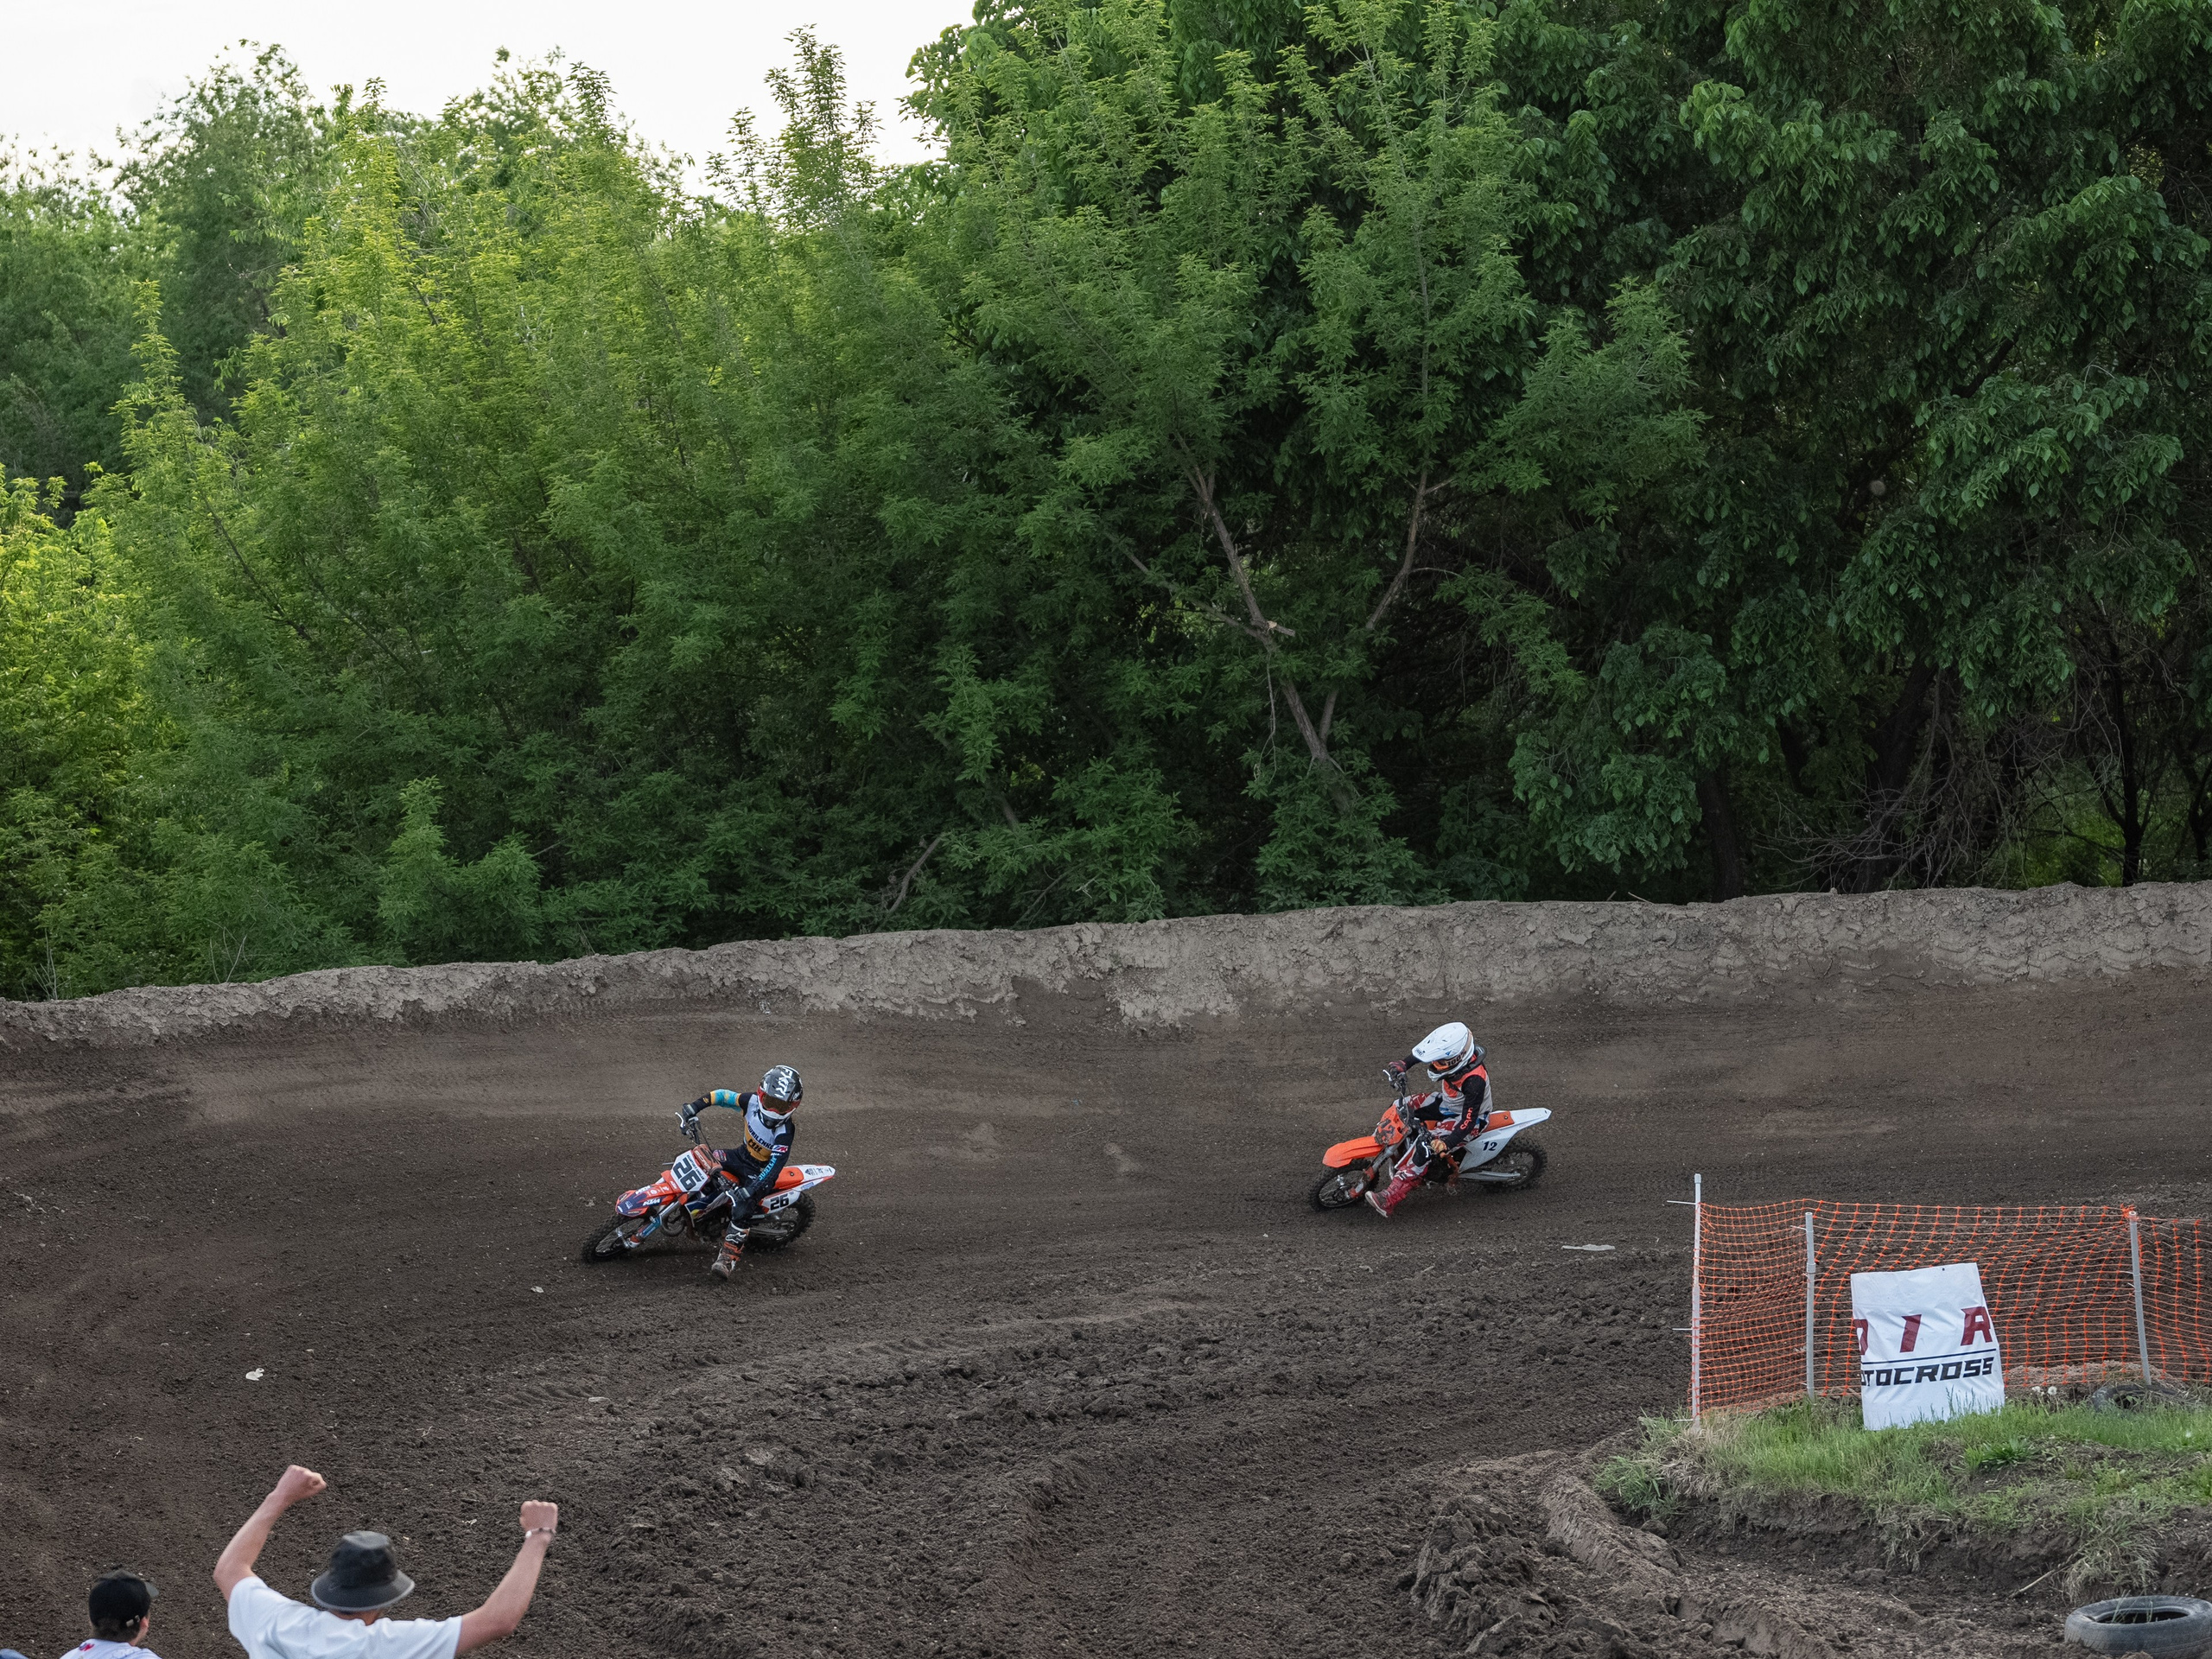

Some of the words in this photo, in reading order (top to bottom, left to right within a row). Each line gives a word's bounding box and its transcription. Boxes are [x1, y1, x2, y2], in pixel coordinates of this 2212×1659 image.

[1446, 1049, 1466, 1066] 100%
[1483, 1141, 1497, 1151] 12
[673, 1157, 702, 1191] 26
[770, 1193, 790, 1211] 26
